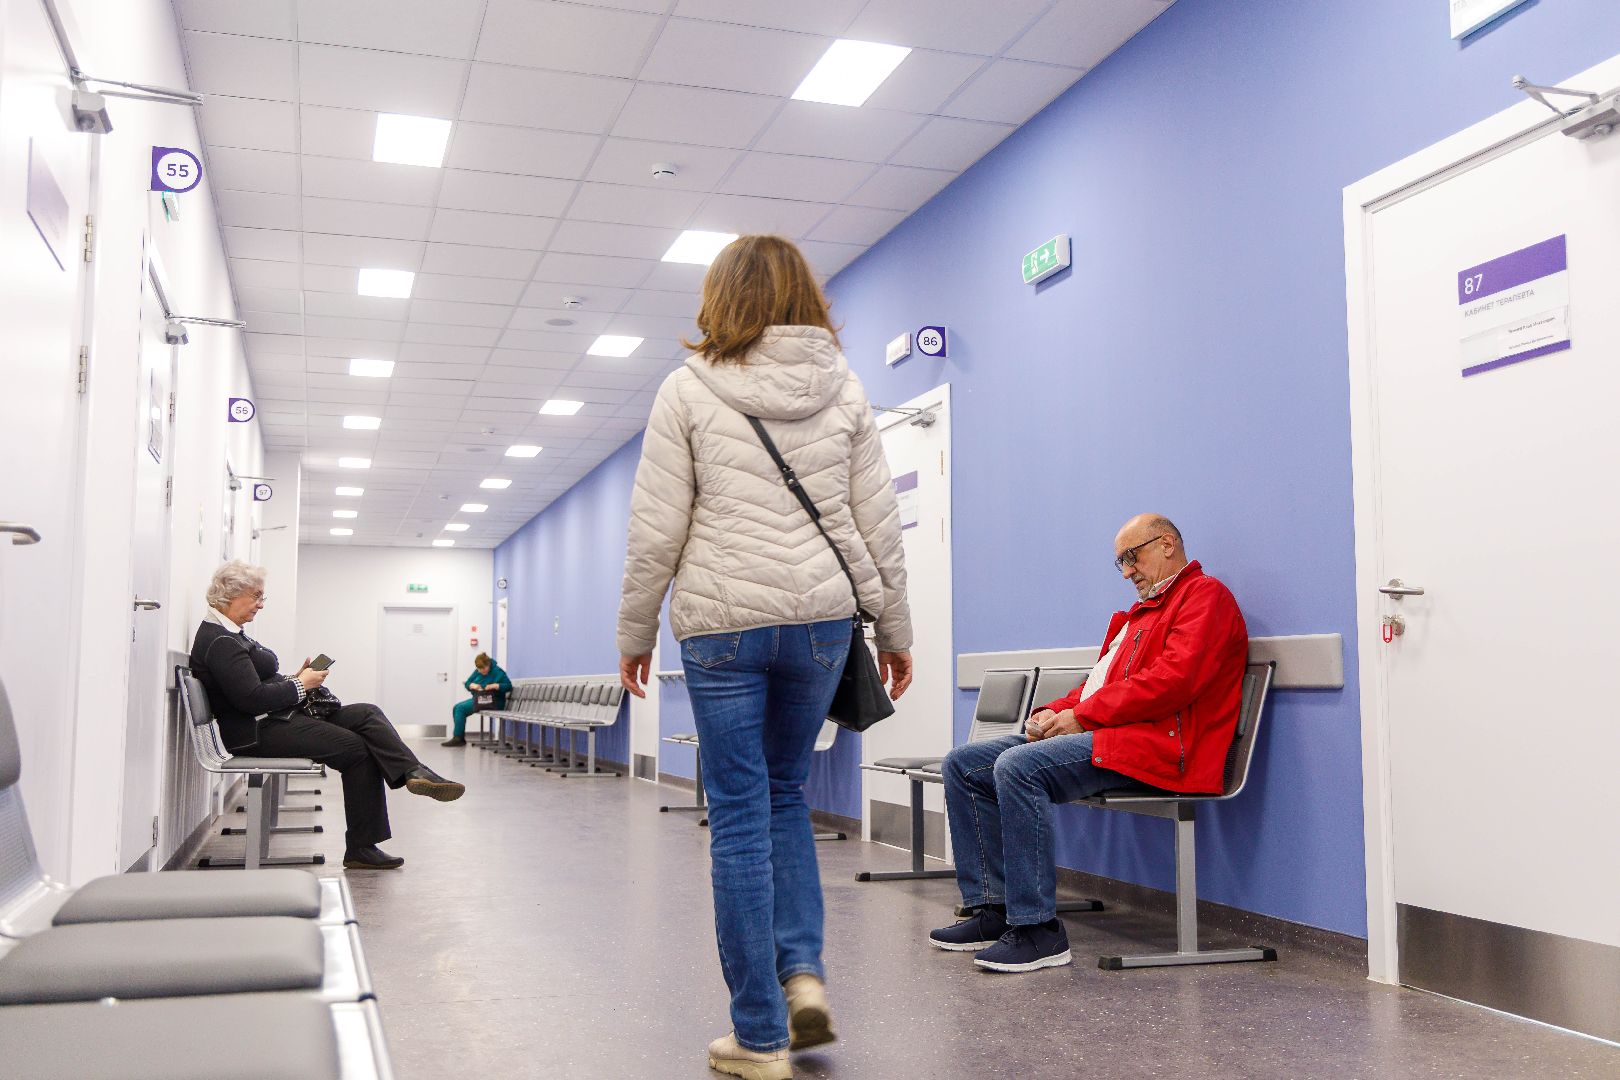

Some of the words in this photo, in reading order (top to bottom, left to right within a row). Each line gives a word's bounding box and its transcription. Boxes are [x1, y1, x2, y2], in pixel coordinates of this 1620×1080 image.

[166, 163, 189, 178] 55
[1464, 273, 1483, 295] 87
[1464, 302, 1494, 317] КАБИНЕТ
[1496, 290, 1535, 306] ТЕРАПЕВТА
[923, 336, 938, 347] 86
[235, 406, 248, 415] 56
